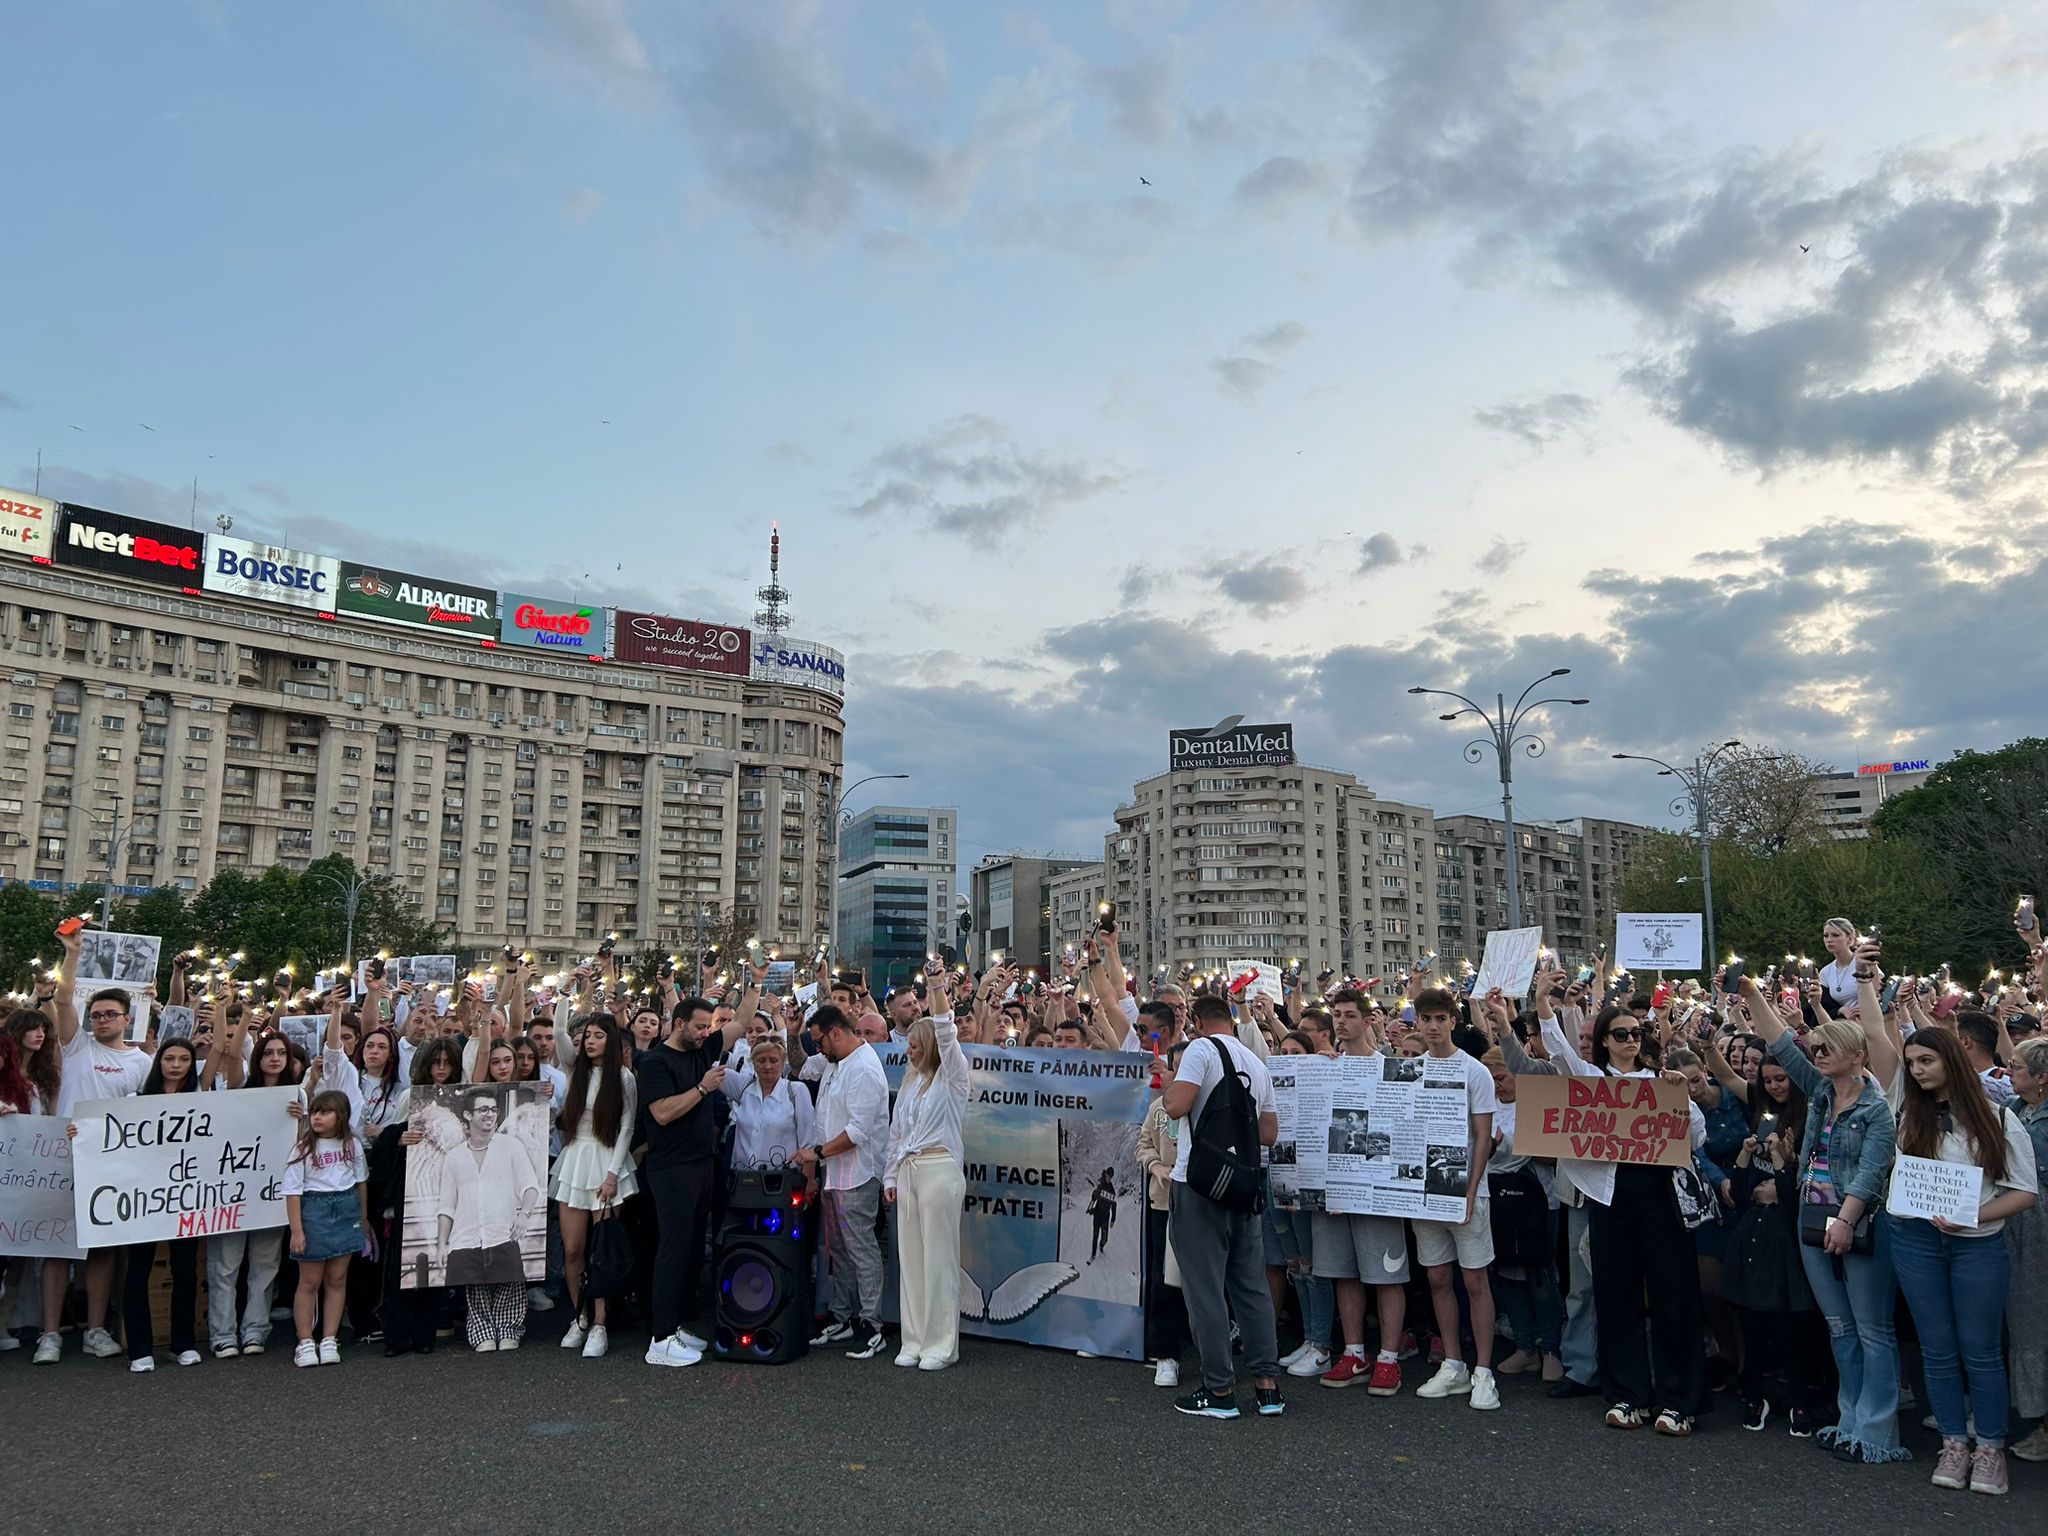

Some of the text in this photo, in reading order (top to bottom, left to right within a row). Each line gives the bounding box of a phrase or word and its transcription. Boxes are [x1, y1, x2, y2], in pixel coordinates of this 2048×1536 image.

[68, 522, 197, 570] NetBet
[216, 548, 327, 593] BORSEC
[395, 581, 491, 619] ALBACHER
[426, 604, 473, 624] Premium
[515, 603, 591, 635] Giusto
[534, 630, 585, 647] Natura
[631, 617, 700, 646] Studio
[662, 647, 694, 658] succeed
[694, 651, 725, 663] together
[777, 650, 845, 681] SANADOR
[1172, 731, 1289, 756] DentalMed
[1173, 752, 1290, 768] Luxury Dental Clinic
[75, 987, 96, 998] REM
[886, 1053, 1144, 1079] MA DINTRE PĂMÂNTENI
[978, 1090, 1028, 1106] ACUM
[1034, 1090, 1093, 1110] ÎNGER.
[101, 1108, 213, 1153] Decizia
[1543, 1108, 1617, 1134] ERAU
[1570, 1134, 1668, 1164] VOȘTRI?
[169, 1149, 198, 1182] de
[996, 1165, 1056, 1187] FACE
[1955, 1169, 1966, 1177] PE
[1904, 1180, 1916, 1189] LA
[964, 1194, 1044, 1219] PTATE!
[1905, 1190, 1960, 1207] TOT RESTUL
[1938, 1206, 1954, 1215] LUI
[176, 1203, 247, 1238] MÂINE
